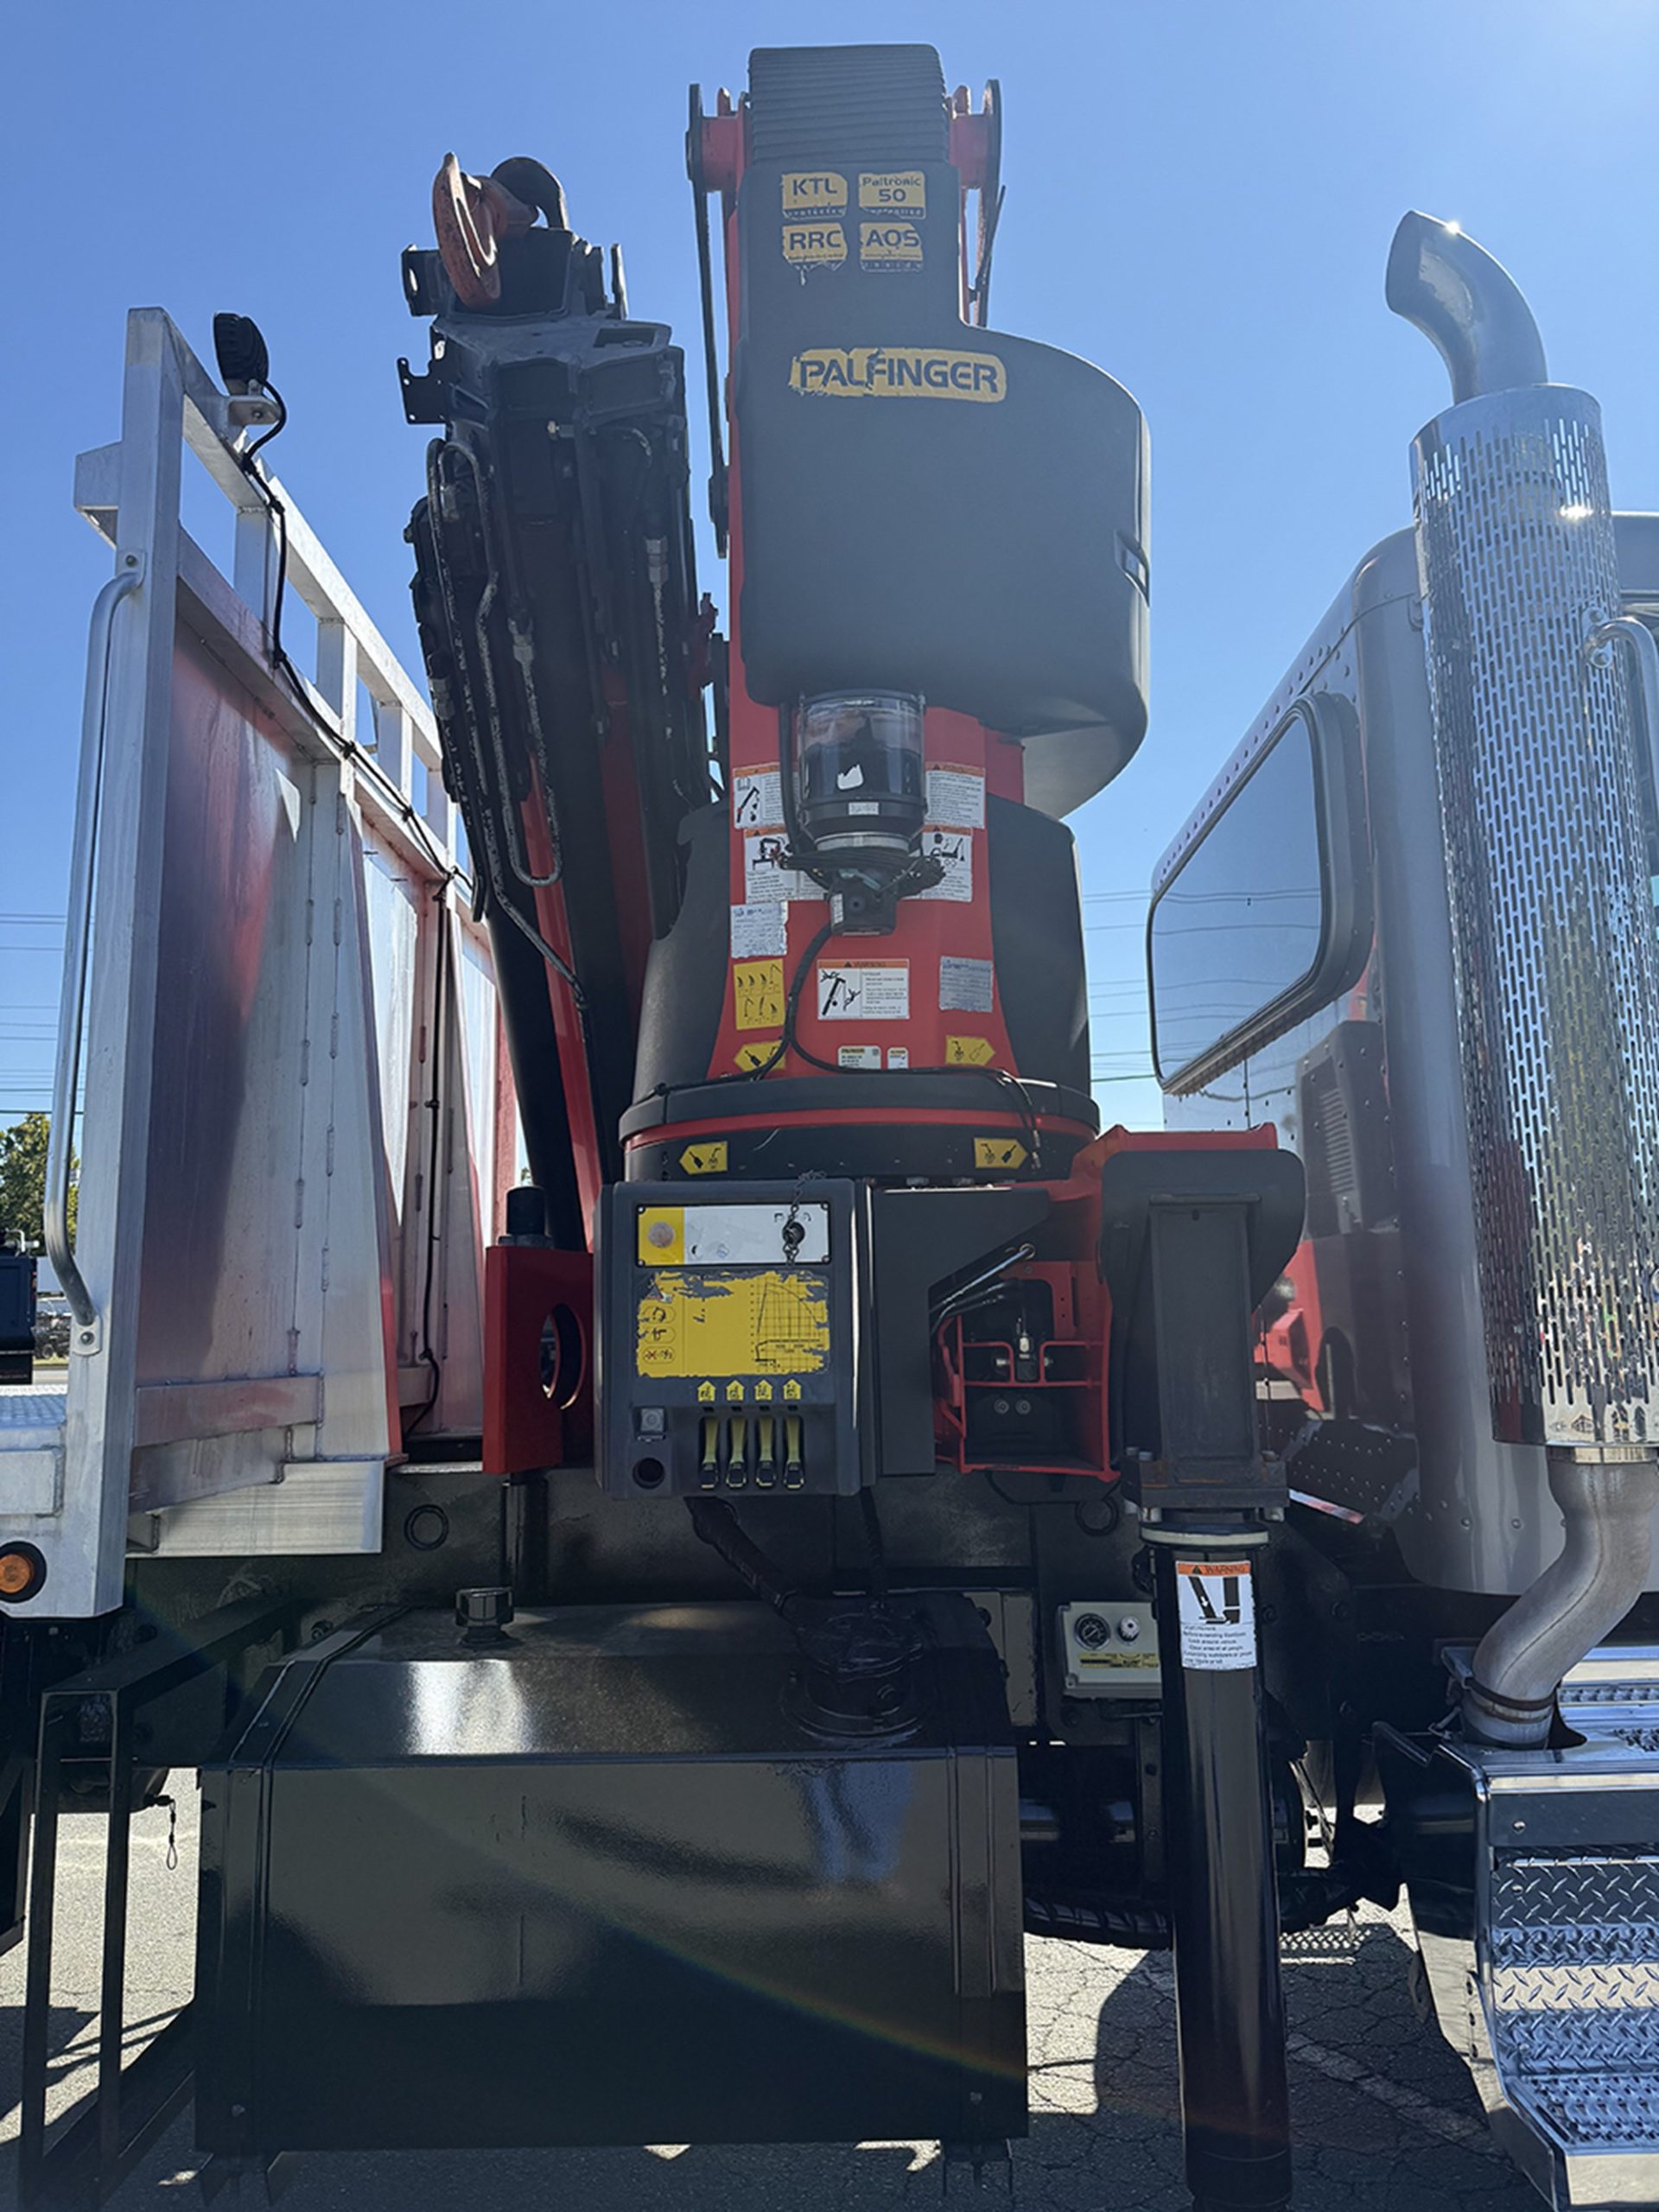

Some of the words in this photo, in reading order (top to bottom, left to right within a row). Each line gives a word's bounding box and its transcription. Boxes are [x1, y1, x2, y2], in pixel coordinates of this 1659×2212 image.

[792, 177, 838, 196] KTL
[879, 188, 906, 202] 50
[789, 230, 842, 251] RRC
[866, 228, 919, 248] AOS
[799, 358, 999, 393] PALFINGER
